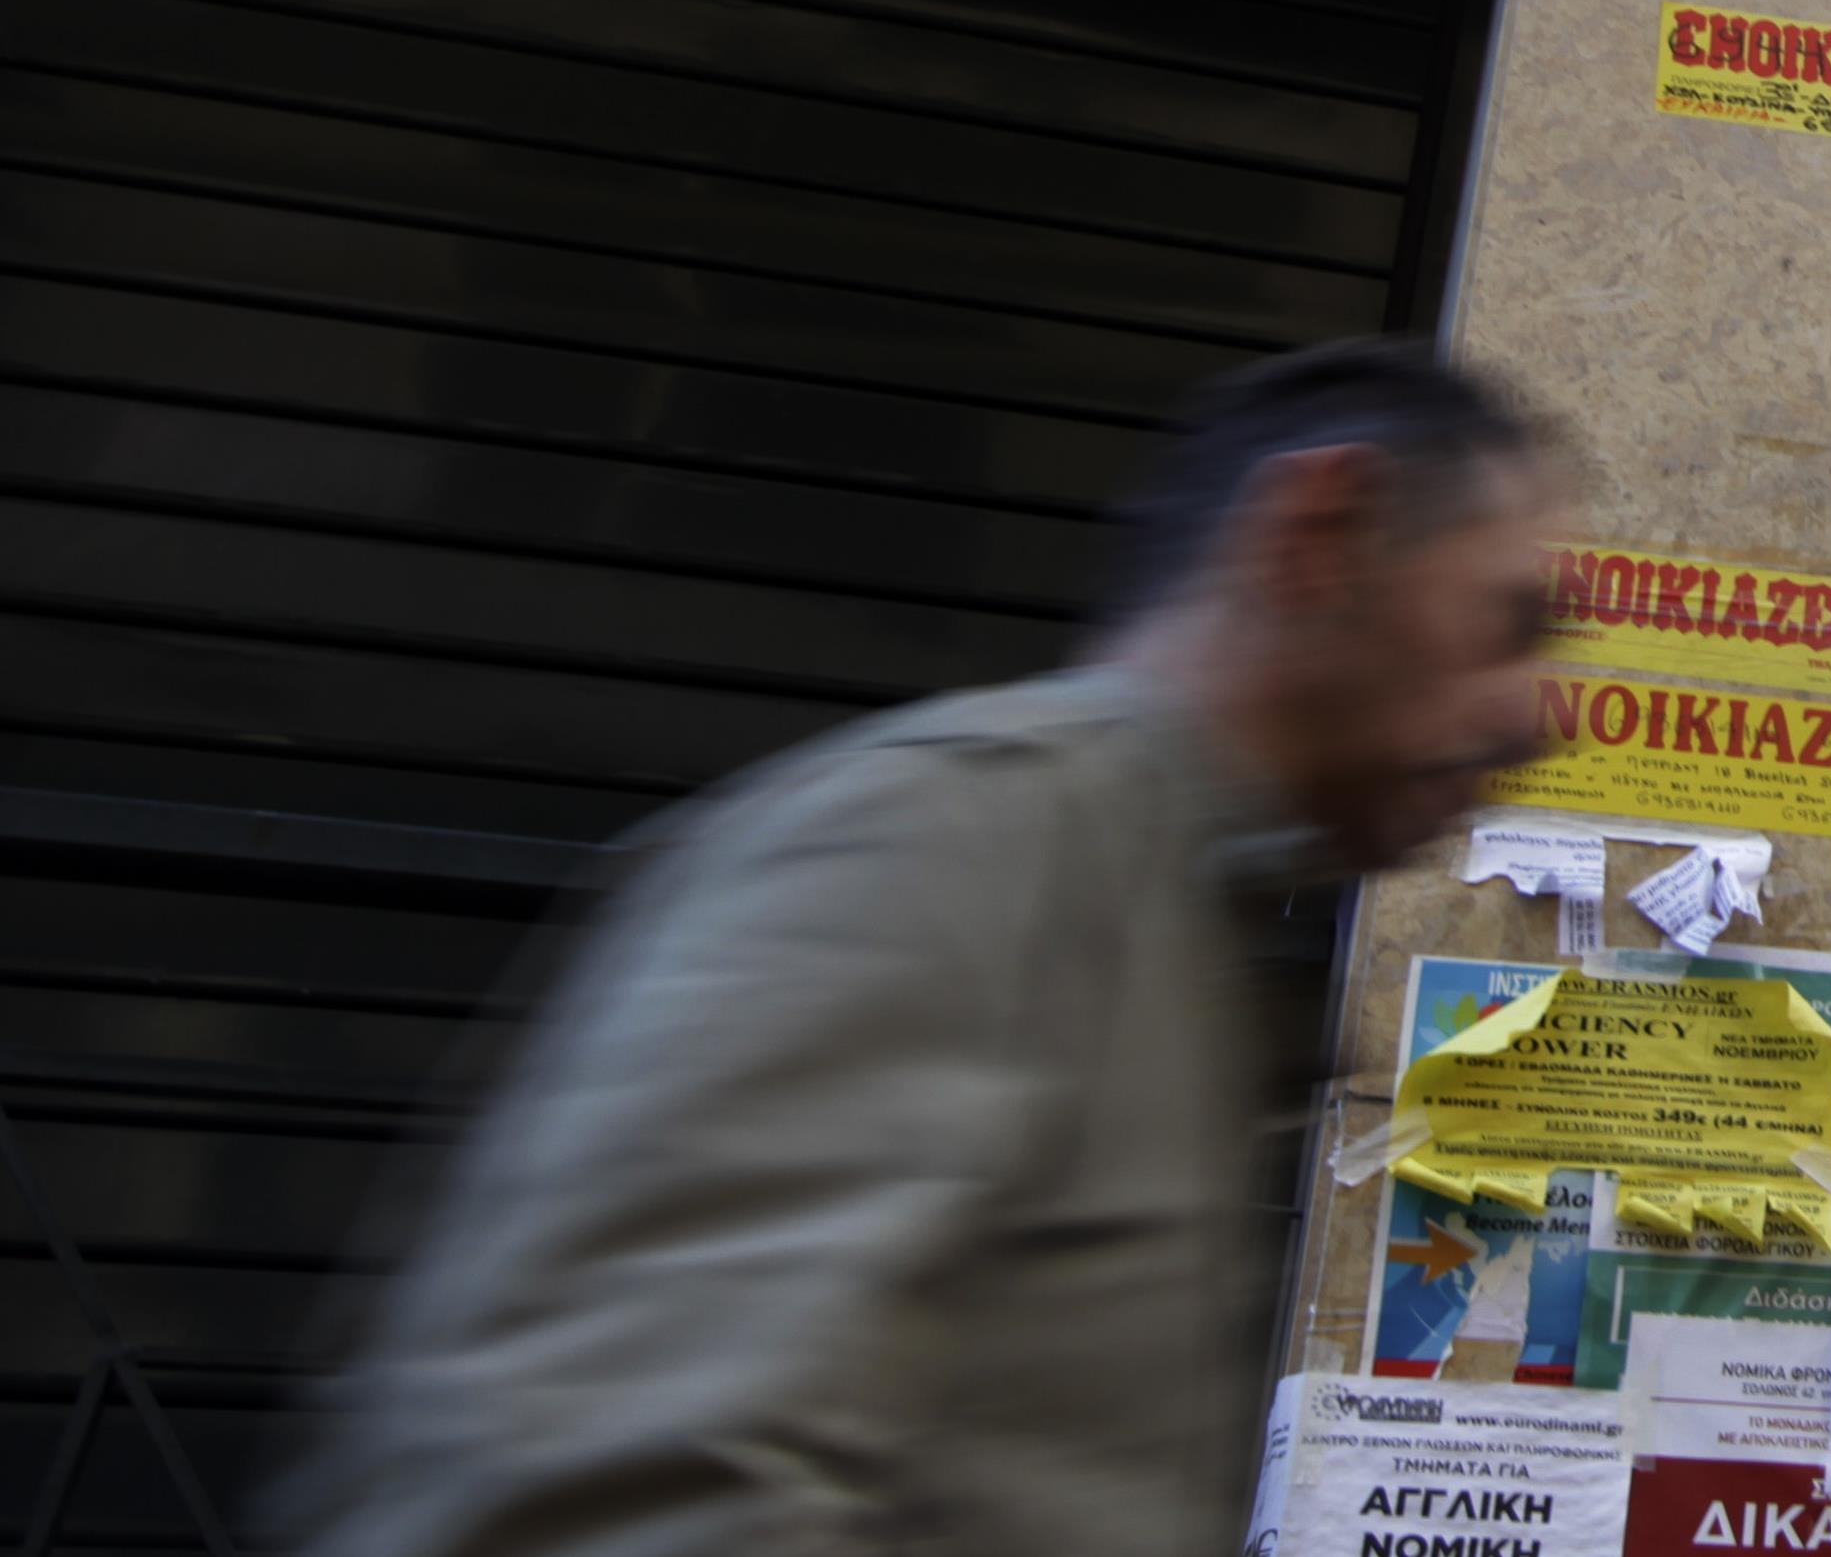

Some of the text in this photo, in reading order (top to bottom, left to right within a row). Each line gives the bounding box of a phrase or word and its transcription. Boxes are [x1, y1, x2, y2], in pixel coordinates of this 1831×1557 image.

[1513, 1036, 1629, 1061] OWER
[1713, 1044, 1819, 1062] ΝΟΕΜΒΡΙΟΥ
[1722, 1362, 1787, 1383] ΝΟΜΙΚΑ
[1767, 1418, 1831, 1435] ΜΟΝΑΔΙΚ
[1391, 1457, 1531, 1481] ΤΜΗΜΑΤΑ ΓΙΑ
[1361, 1486, 1554, 1525] ΑΓΓΛΙΚΗ
[1361, 1532, 1542, 1557] ΝΟΜΙΚΗ
